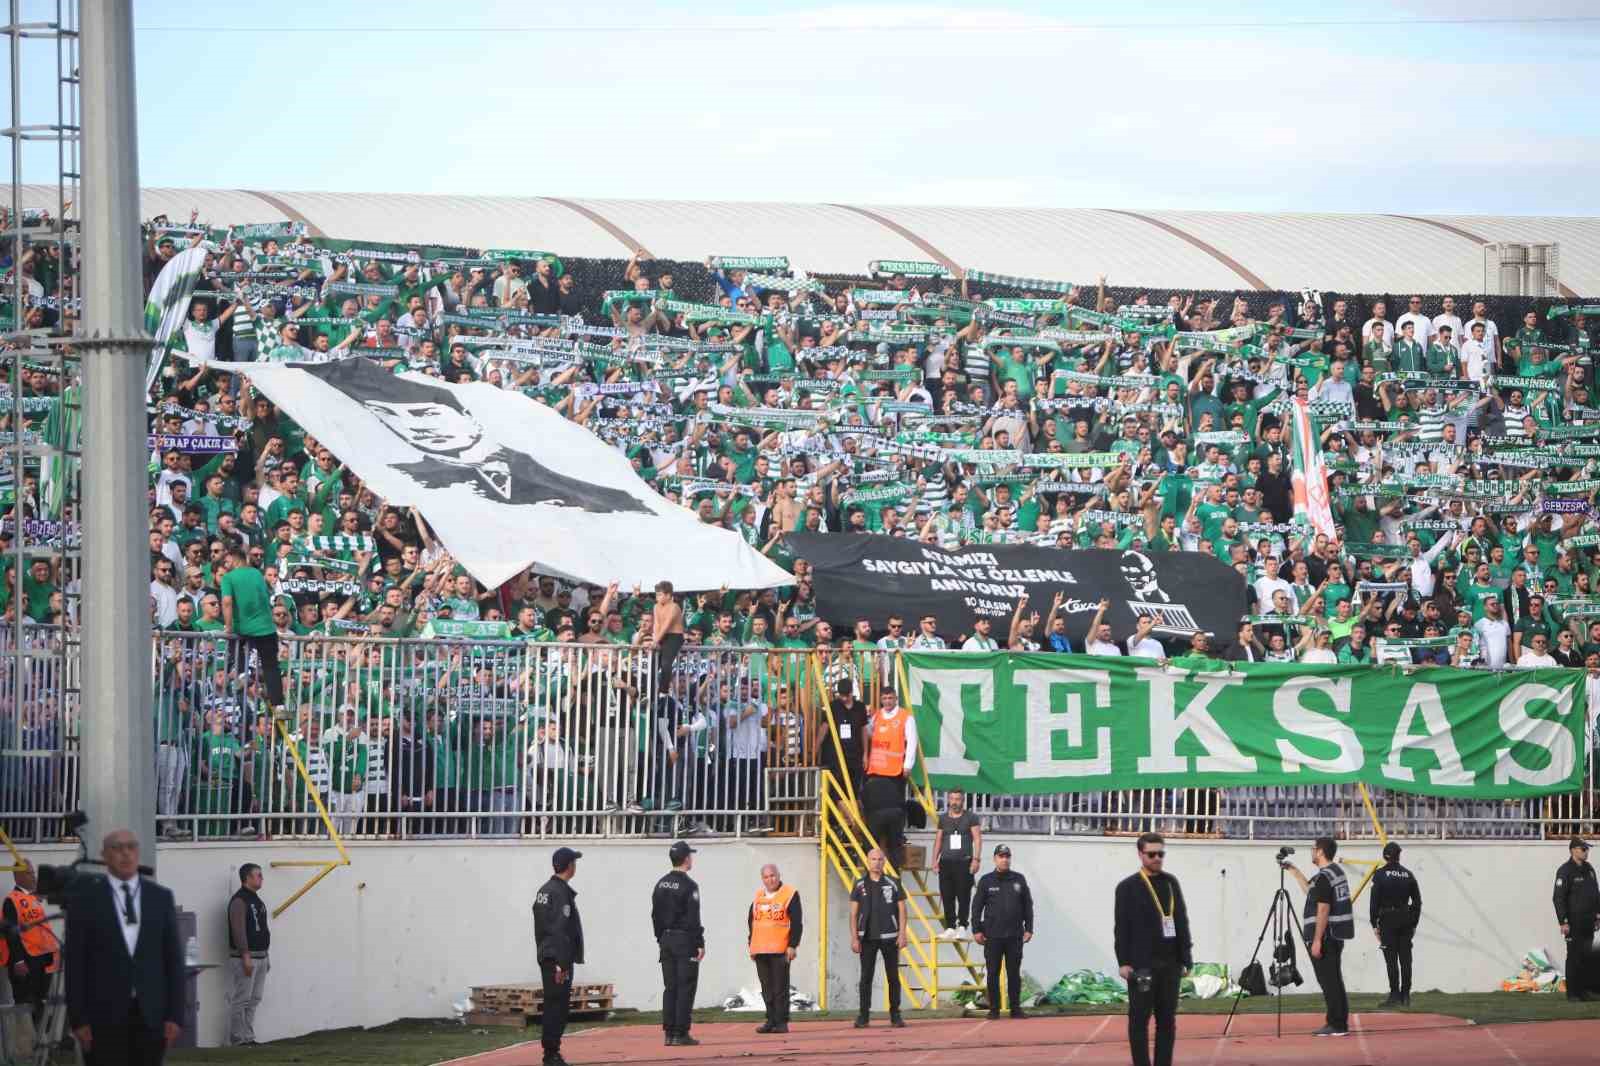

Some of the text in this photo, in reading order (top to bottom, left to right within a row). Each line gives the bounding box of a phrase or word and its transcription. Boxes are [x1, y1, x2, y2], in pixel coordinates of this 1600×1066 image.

[862, 558, 1078, 584] SAYGIYLA VE ÖZLEMLE
[930, 578, 1030, 599] ANIYORUZ
[908, 663, 1577, 787] TEKSAS
